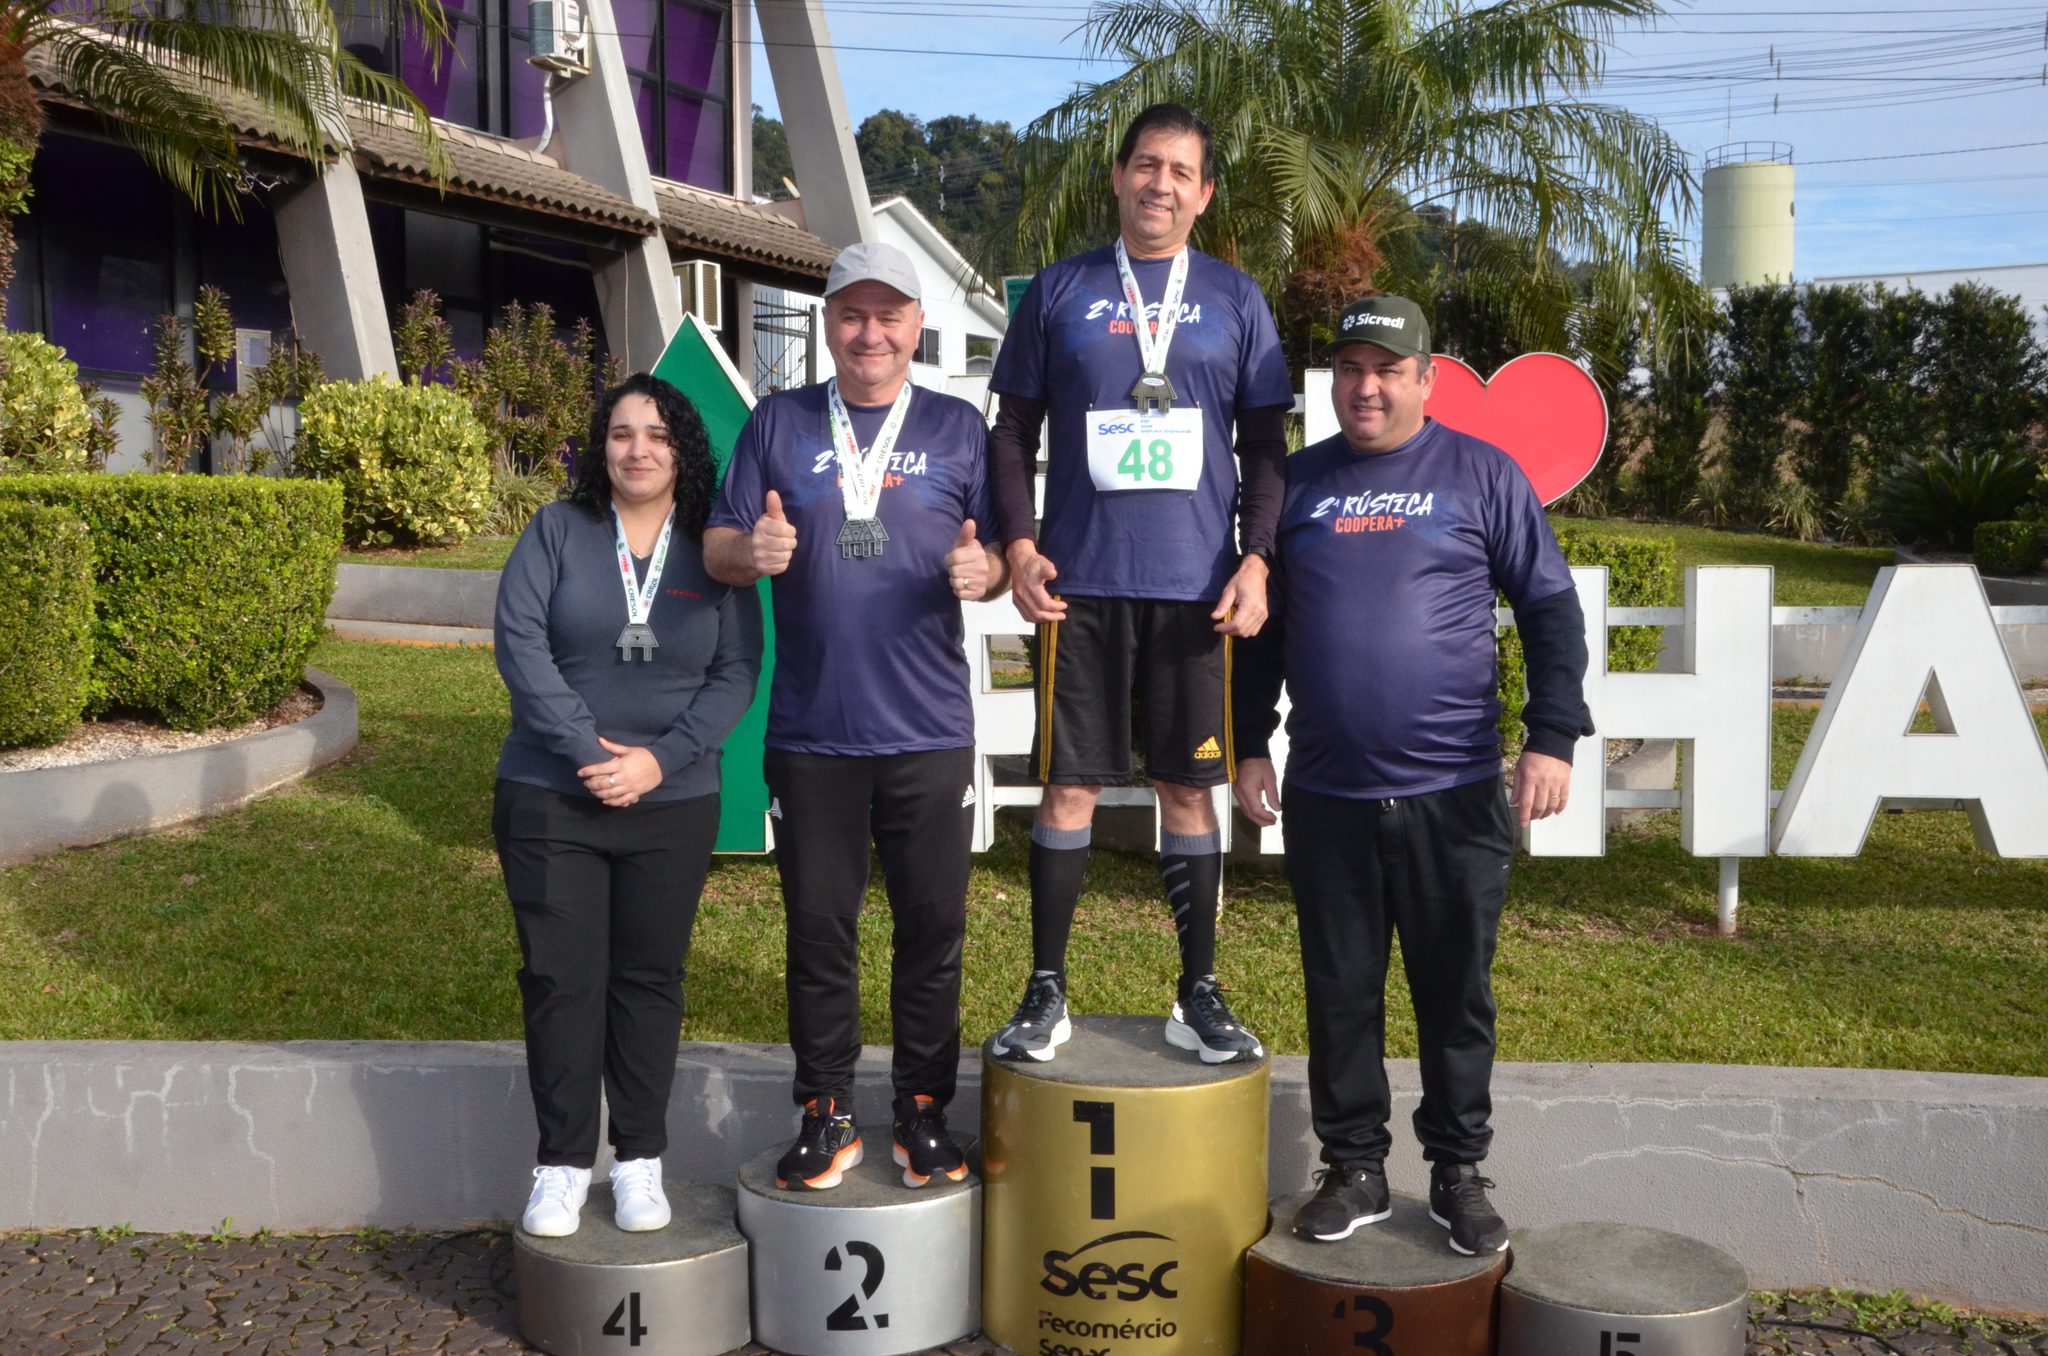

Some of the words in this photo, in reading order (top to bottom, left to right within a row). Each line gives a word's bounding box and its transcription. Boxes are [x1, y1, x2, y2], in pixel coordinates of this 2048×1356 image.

[1355, 312, 1406, 330] Sicredi
[1117, 438, 1174, 482] 48
[1342, 489, 1435, 517] RÚSTICA
[627, 587, 638, 618] CRESOL
[1194, 750, 1222, 760] adidas
[1072, 1100, 1116, 1221] 1
[823, 1240, 890, 1331] 2
[602, 1292, 648, 1347] 4
[1038, 1309, 1178, 1340] Fecomércio
